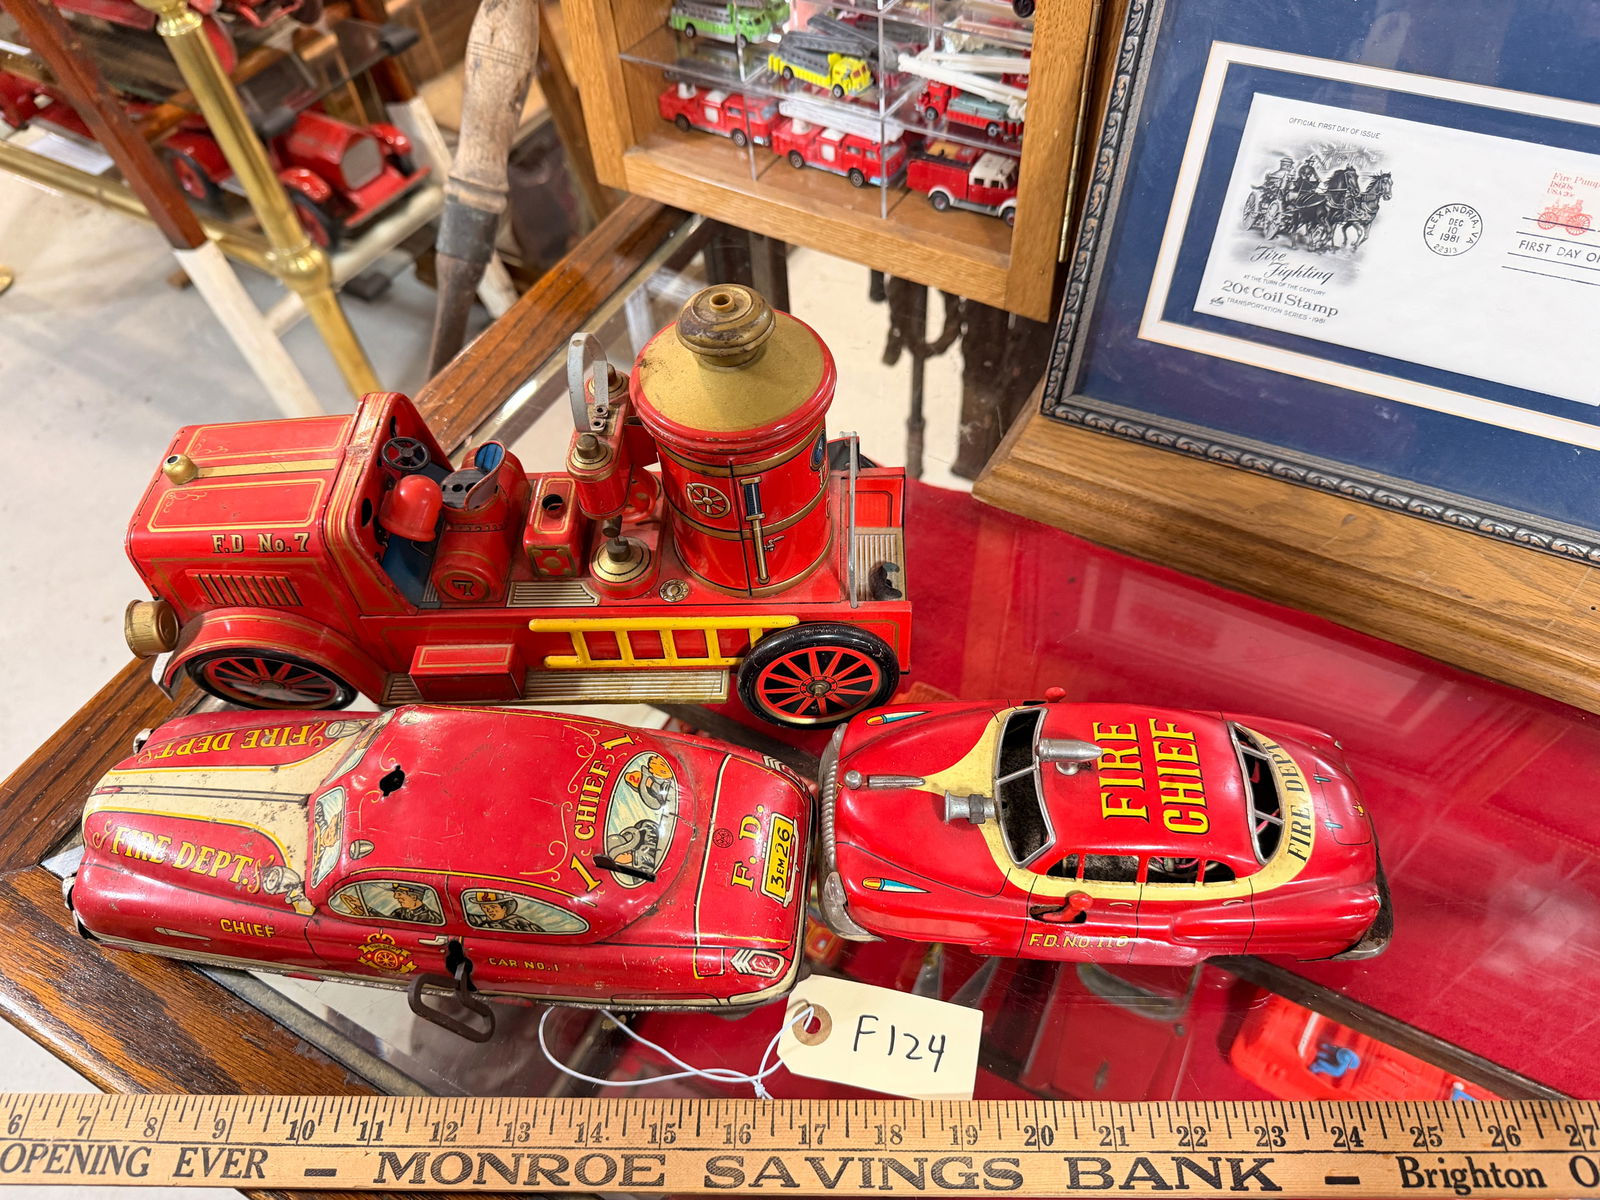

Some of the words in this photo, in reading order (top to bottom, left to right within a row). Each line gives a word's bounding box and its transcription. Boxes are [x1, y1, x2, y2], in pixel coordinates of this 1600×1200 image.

[1289, 117, 1317, 128] OFFICIAL
[1318, 122, 1336, 131] FIRST
[1336, 125, 1350, 133] DAY
[1360, 130, 1381, 139] ISSUE
[1553, 171, 1573, 182] Fire
[1447, 226, 1458, 235] 10
[1448, 217, 1465, 227] DEC
[1440, 232, 1460, 243] 1981
[1465, 231, 1480, 244] VA
[1250, 245, 1287, 262] Fire
[1519, 240, 1552, 254] FIRST
[1556, 246, 1582, 259] DAY
[1264, 261, 1335, 286] Fighting
[1262, 278, 1279, 286] TURN
[1287, 282, 1299, 290] THE
[1299, 285, 1326, 296] CENTURY
[1226, 297, 1282, 314] TRANSPORTATION
[1283, 310, 1308, 321] SERIES
[1252, 286, 1283, 304] Coil
[1284, 293, 1339, 318] Stamp
[452, 580, 474, 596] 7
[240, 725, 314, 749] FIRE
[600, 732, 636, 751] 1
[1092, 721, 1150, 823] FIRE
[1148, 717, 1211, 835] CHIEF
[573, 759, 611, 842] CHIEF
[1286, 804, 1313, 863] FIRE
[110, 826, 173, 865] FIRE
[172, 841, 254, 886] DEPT.
[569, 852, 603, 893] 1
[219, 917, 277, 938] CHIEF
[488, 957, 518, 967] CAR
[853, 1014, 947, 1073] F124
[7, 1114, 23, 1135] 6
[77, 1115, 92, 1136] 7
[143, 1116, 158, 1138] 8
[212, 1118, 227, 1139] 9
[286, 1118, 316, 1141] 10
[358, 1120, 385, 1142] 11
[429, 1120, 459, 1143] 12
[501, 1121, 531, 1143] 13
[574, 1122, 603, 1144] 14
[648, 1123, 677, 1145] 15
[723, 1123, 752, 1145] 16
[798, 1124, 827, 1145] 17
[874, 1124, 904, 1145] 18
[950, 1125, 979, 1146] 19
[1023, 1124, 1055, 1147] 20
[1098, 1125, 1130, 1147] 21
[1176, 1125, 1209, 1147] 22
[1253, 1125, 1287, 1148] 23
[1330, 1125, 1364, 1148] 24
[1410, 1125, 1443, 1147] 25
[1487, 1125, 1522, 1147] 26
[1564, 1124, 1597, 1147] 27
[0, 1142, 152, 1178] OPENING
[173, 1146, 270, 1180] EVER
[373, 1150, 666, 1187] MONROE
[704, 1154, 1025, 1191] SAVINGS
[1064, 1156, 1283, 1192] BANK
[1395, 1154, 1548, 1196] Brighton
